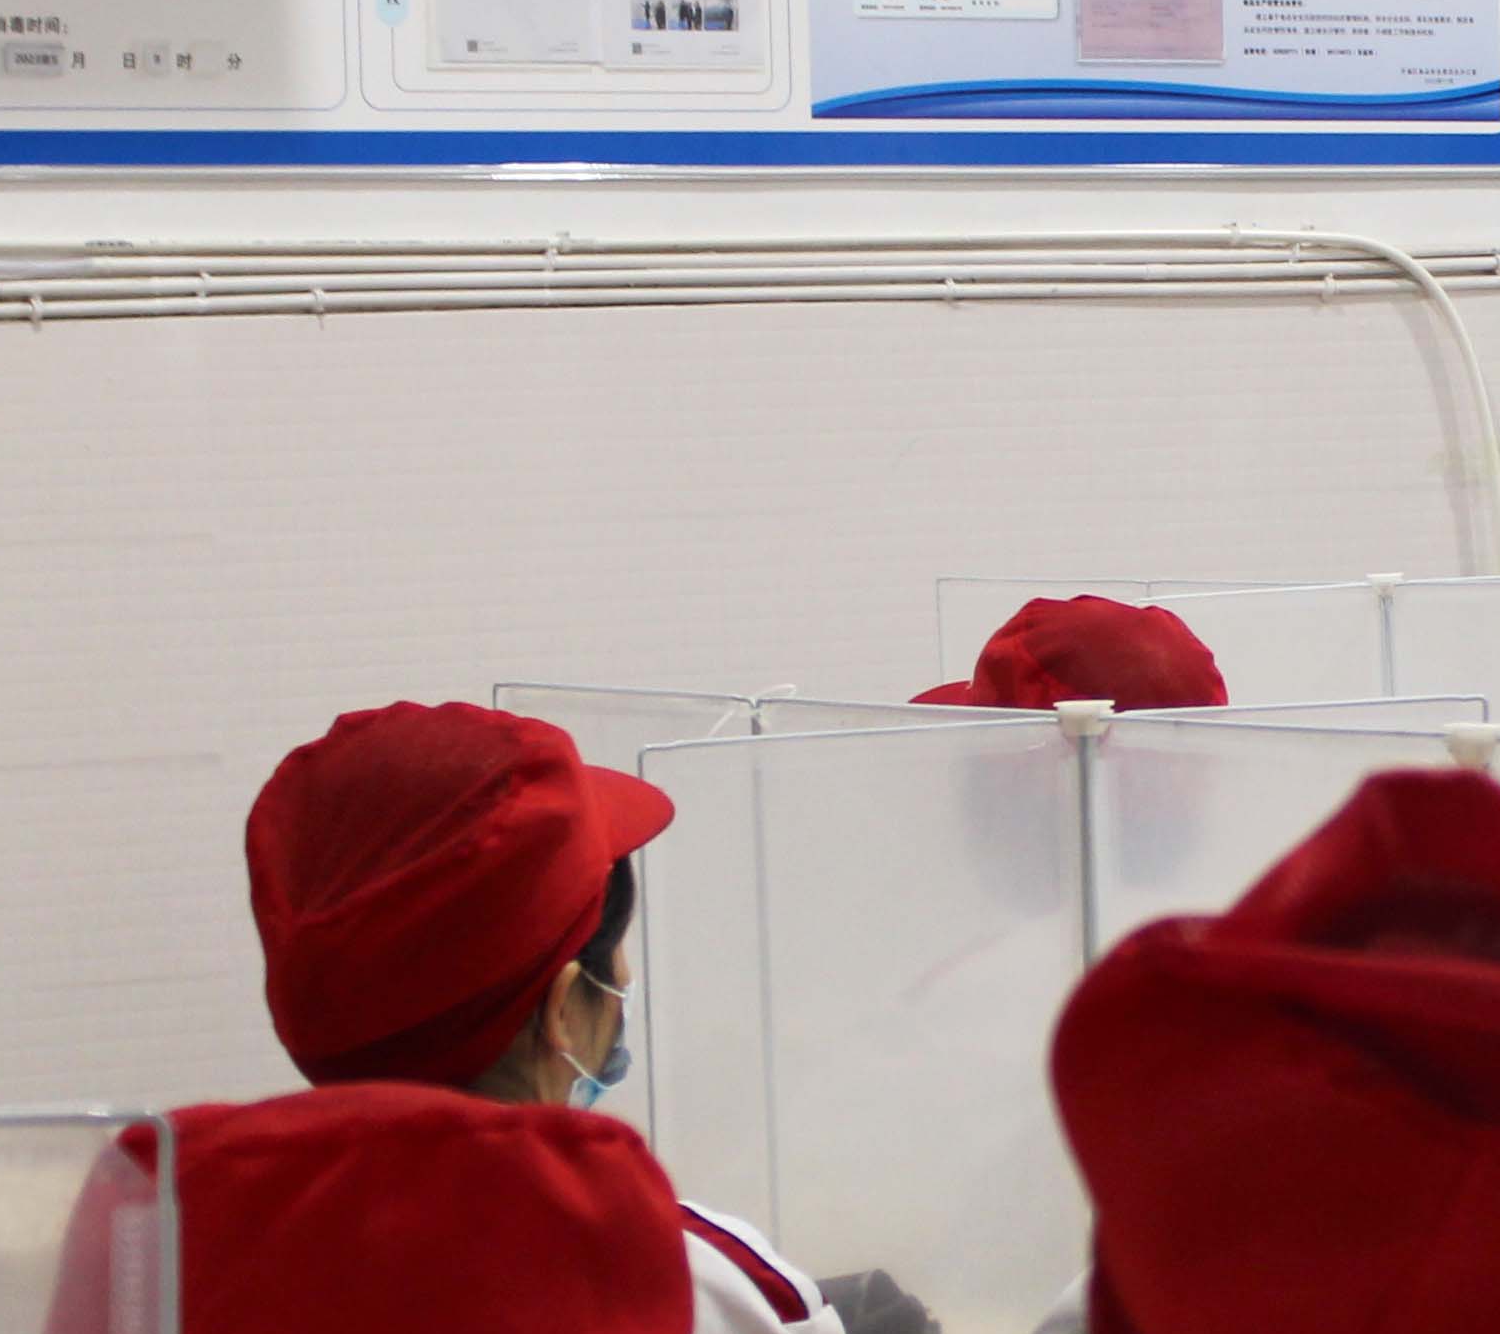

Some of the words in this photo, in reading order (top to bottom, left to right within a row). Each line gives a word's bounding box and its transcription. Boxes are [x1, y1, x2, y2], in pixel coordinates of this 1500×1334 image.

[122, 52, 136, 70] 日
[177, 53, 192, 70] 时
[227, 52, 242, 70] 分
